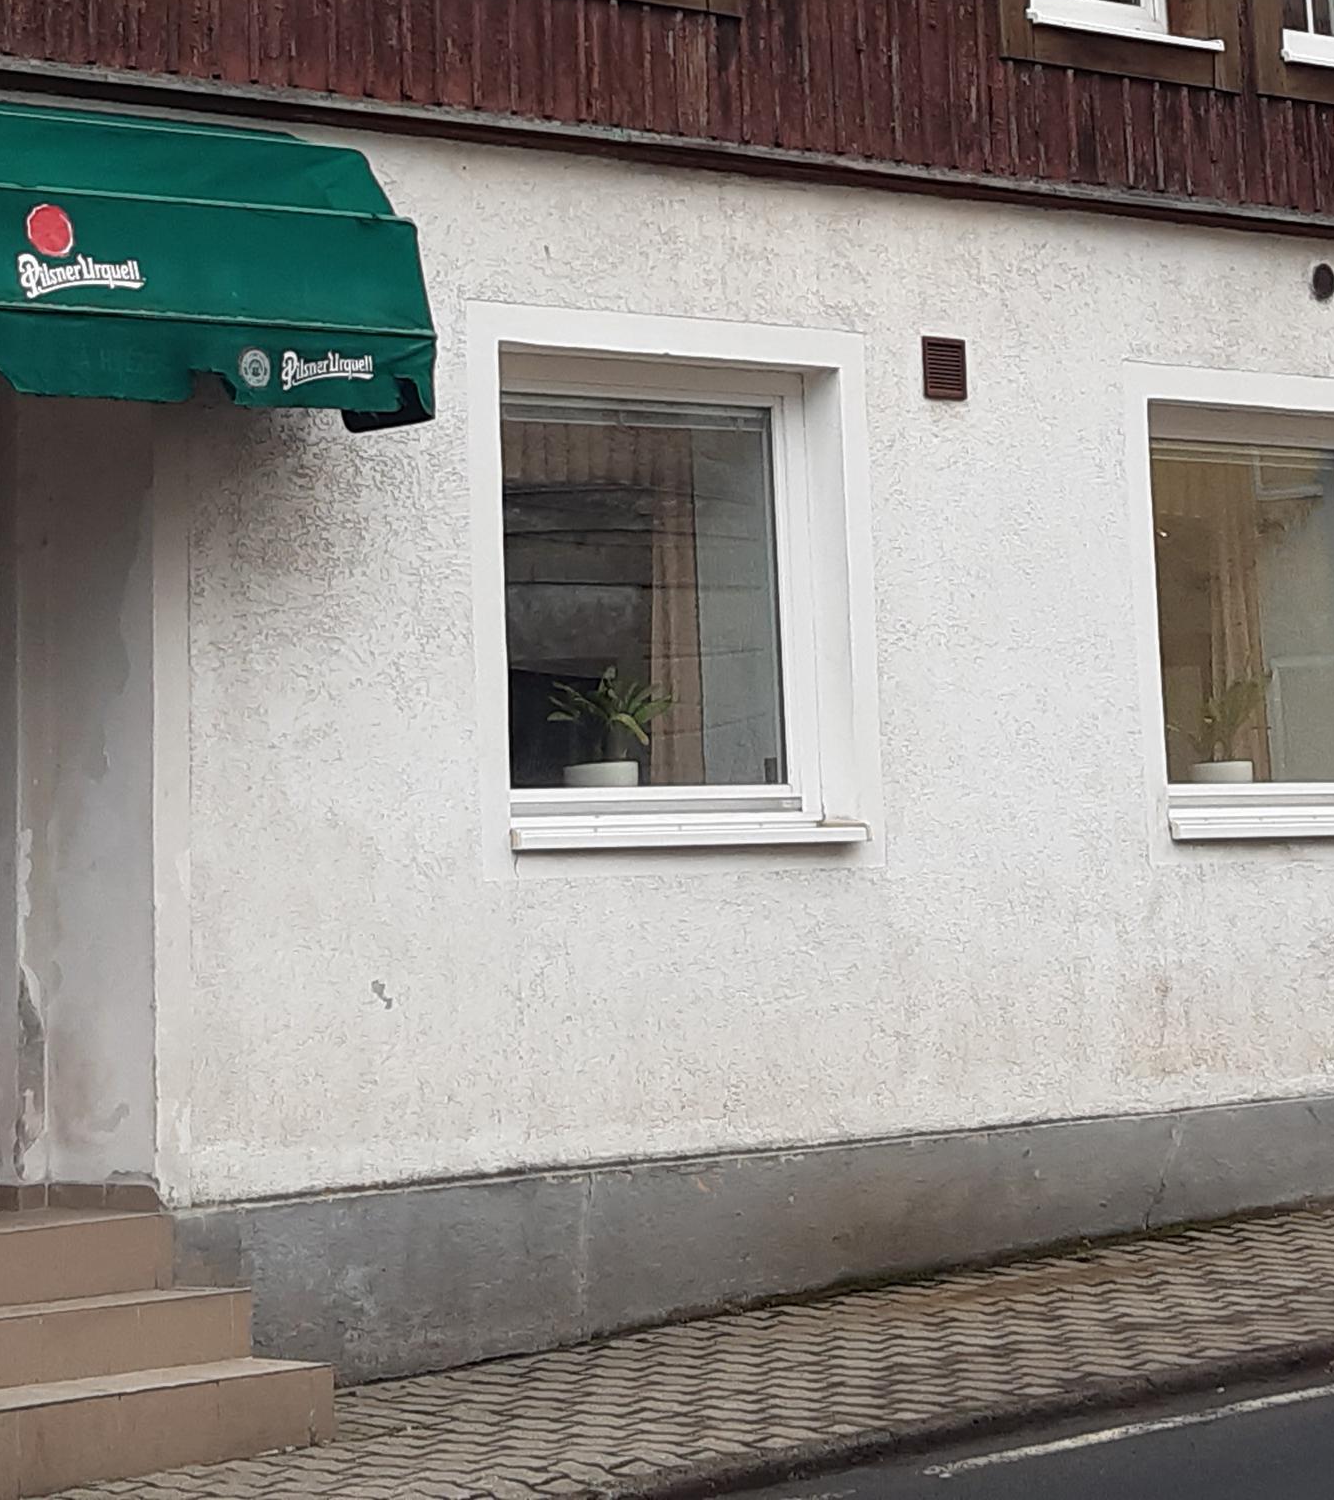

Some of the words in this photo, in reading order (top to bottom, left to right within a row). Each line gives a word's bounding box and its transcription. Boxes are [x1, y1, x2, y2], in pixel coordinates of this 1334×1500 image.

[18, 253, 81, 298] Pilsner
[78, 254, 141, 289] Urquell
[281, 350, 329, 391] Pilsner
[328, 349, 373, 380] Urquell
